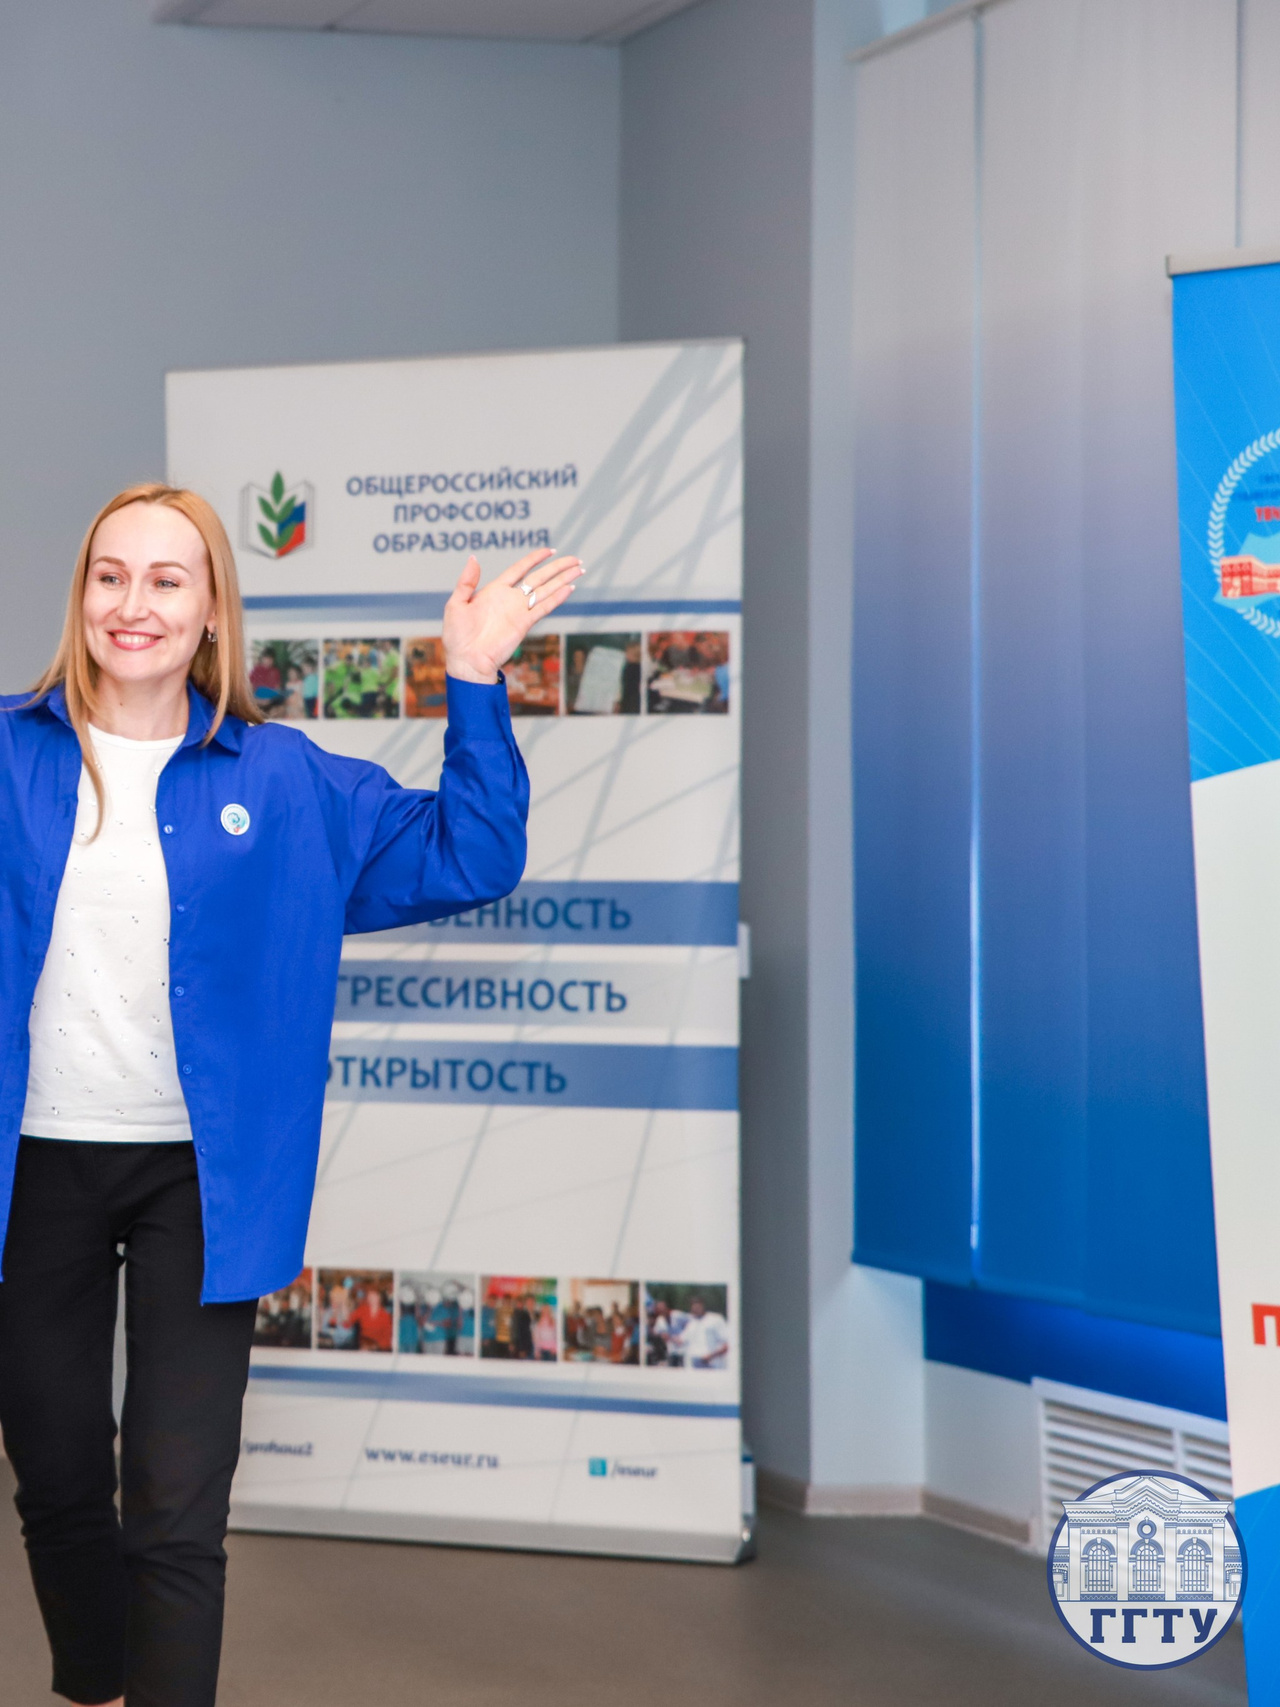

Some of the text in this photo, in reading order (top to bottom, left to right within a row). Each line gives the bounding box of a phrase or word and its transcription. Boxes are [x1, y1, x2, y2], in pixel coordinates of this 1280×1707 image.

[346, 464, 578, 497] ОБЩЕРОССИЙСКИЙ
[393, 499, 531, 523] ПРОФСОЮЗ
[373, 529, 550, 553] ОБРАЗОВАНИЯ
[327, 1055, 567, 1093] ТКРЫТОСТЬ
[365, 1448, 499, 1470] www.eseur.ru
